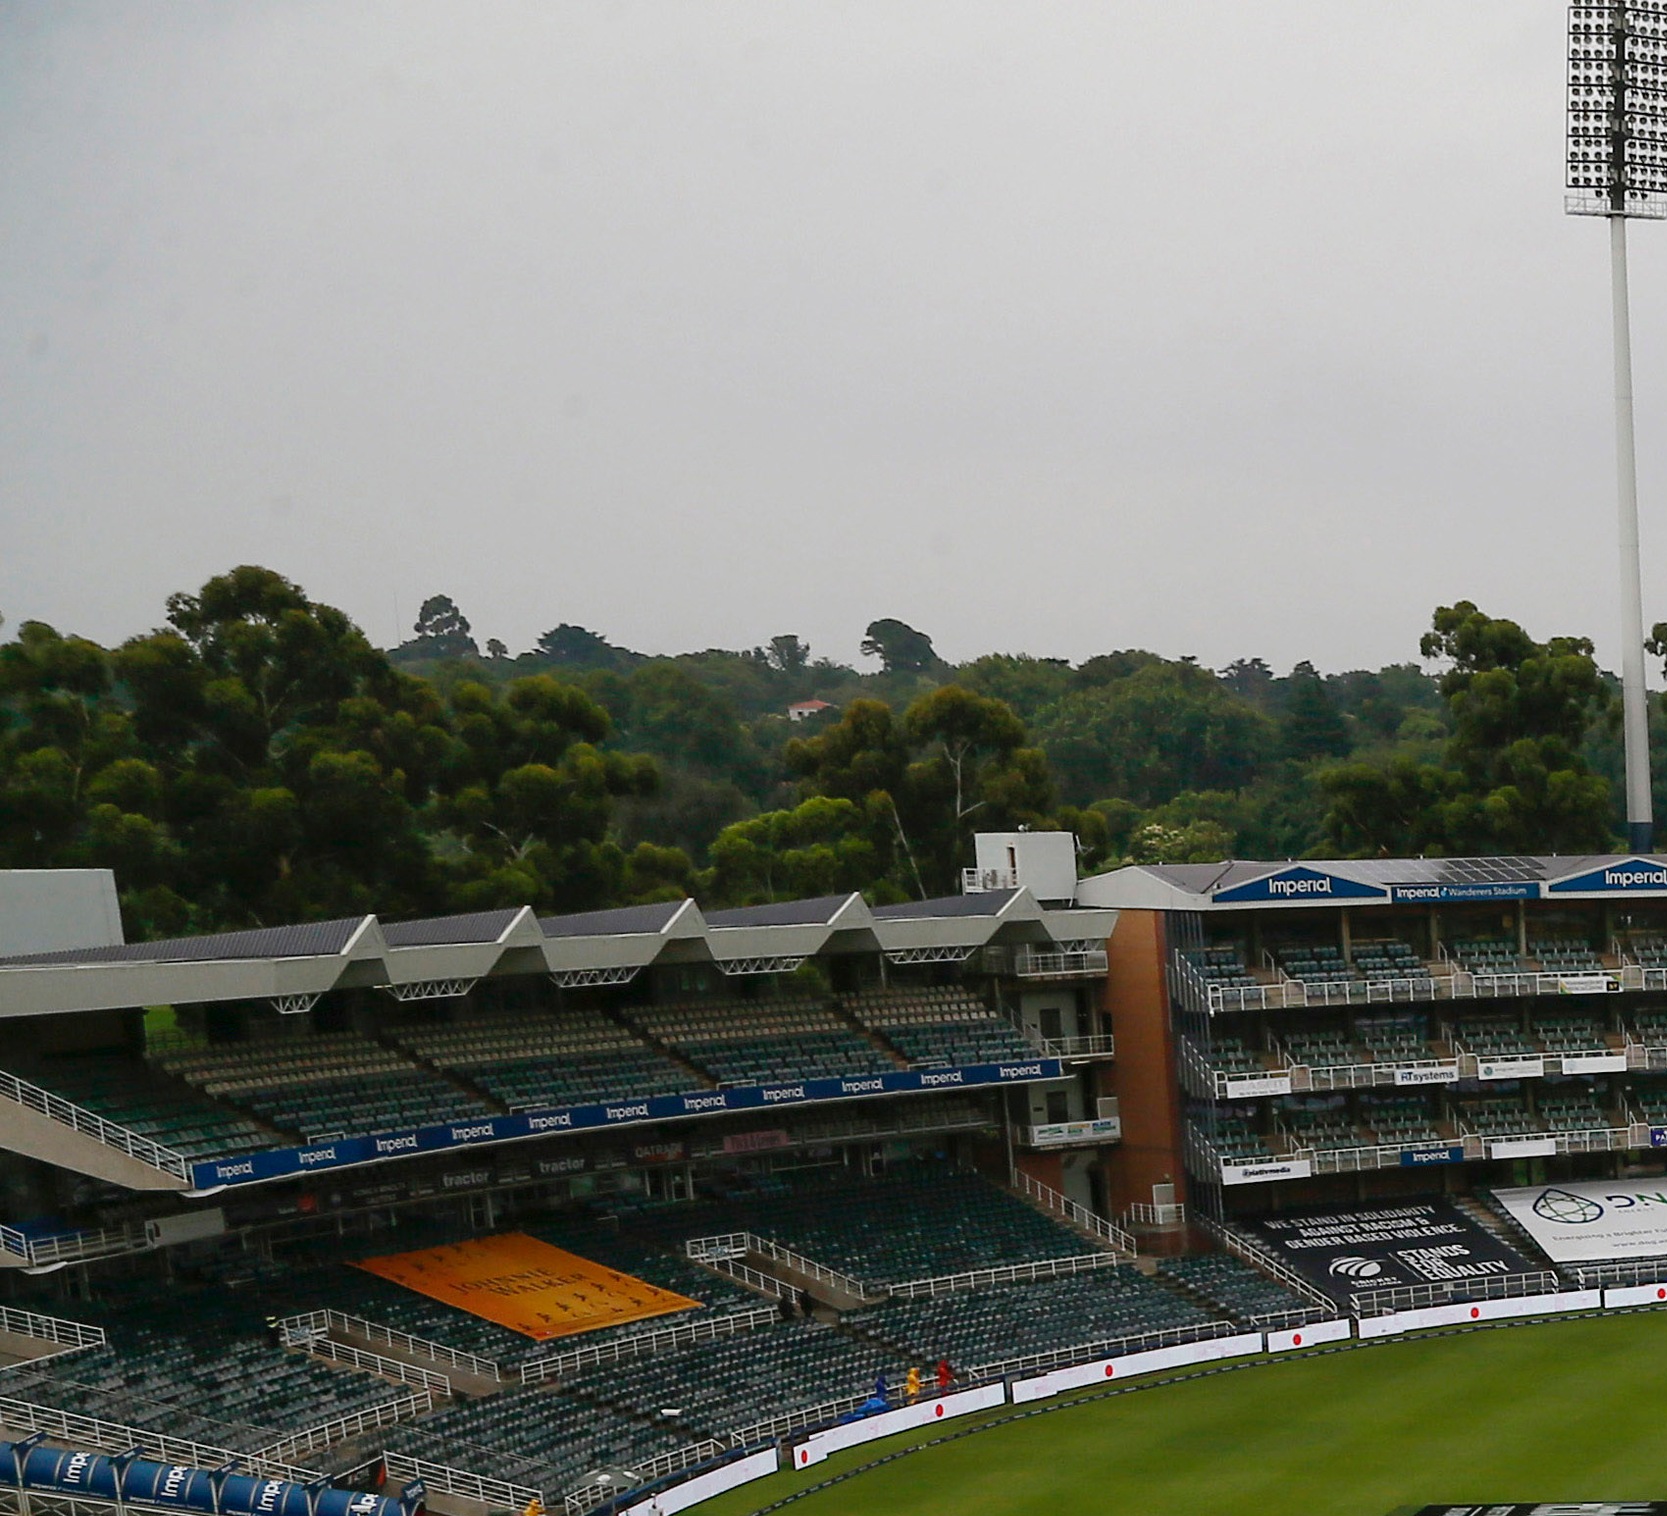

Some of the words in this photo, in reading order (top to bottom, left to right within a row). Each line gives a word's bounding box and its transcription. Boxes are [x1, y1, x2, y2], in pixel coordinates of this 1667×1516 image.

[1268, 876, 1332, 896] Imperial
[1397, 885, 1440, 900] Imperial
[1448, 886, 1491, 898] Wanderers
[1494, 885, 1527, 896] Stadium
[1000, 1062, 1042, 1081] Imperial
[763, 1086, 805, 1104] Imperial
[842, 1077, 884, 1095] Imperial
[606, 1103, 649, 1120] Imperial
[684, 1093, 726, 1112] Imperial
[529, 1111, 572, 1132] Imperial
[451, 1122, 494, 1142] Imperial
[299, 1145, 336, 1165] Imperial
[216, 1160, 254, 1180] Imperial
[1264, 1219, 1290, 1230] WE
[1292, 1213, 1339, 1228] STAND
[1341, 1212, 1355, 1223] IN
[1356, 1205, 1437, 1222] SOLIDARITY
[1299, 1222, 1363, 1238] AGAINST
[1364, 1218, 1418, 1232] RACISM
[1284, 1236, 1346, 1250] GENDER
[1346, 1231, 1391, 1246] BASED
[1397, 1244, 1471, 1261] STANDS
[1421, 1260, 1512, 1281] EQUALITY
